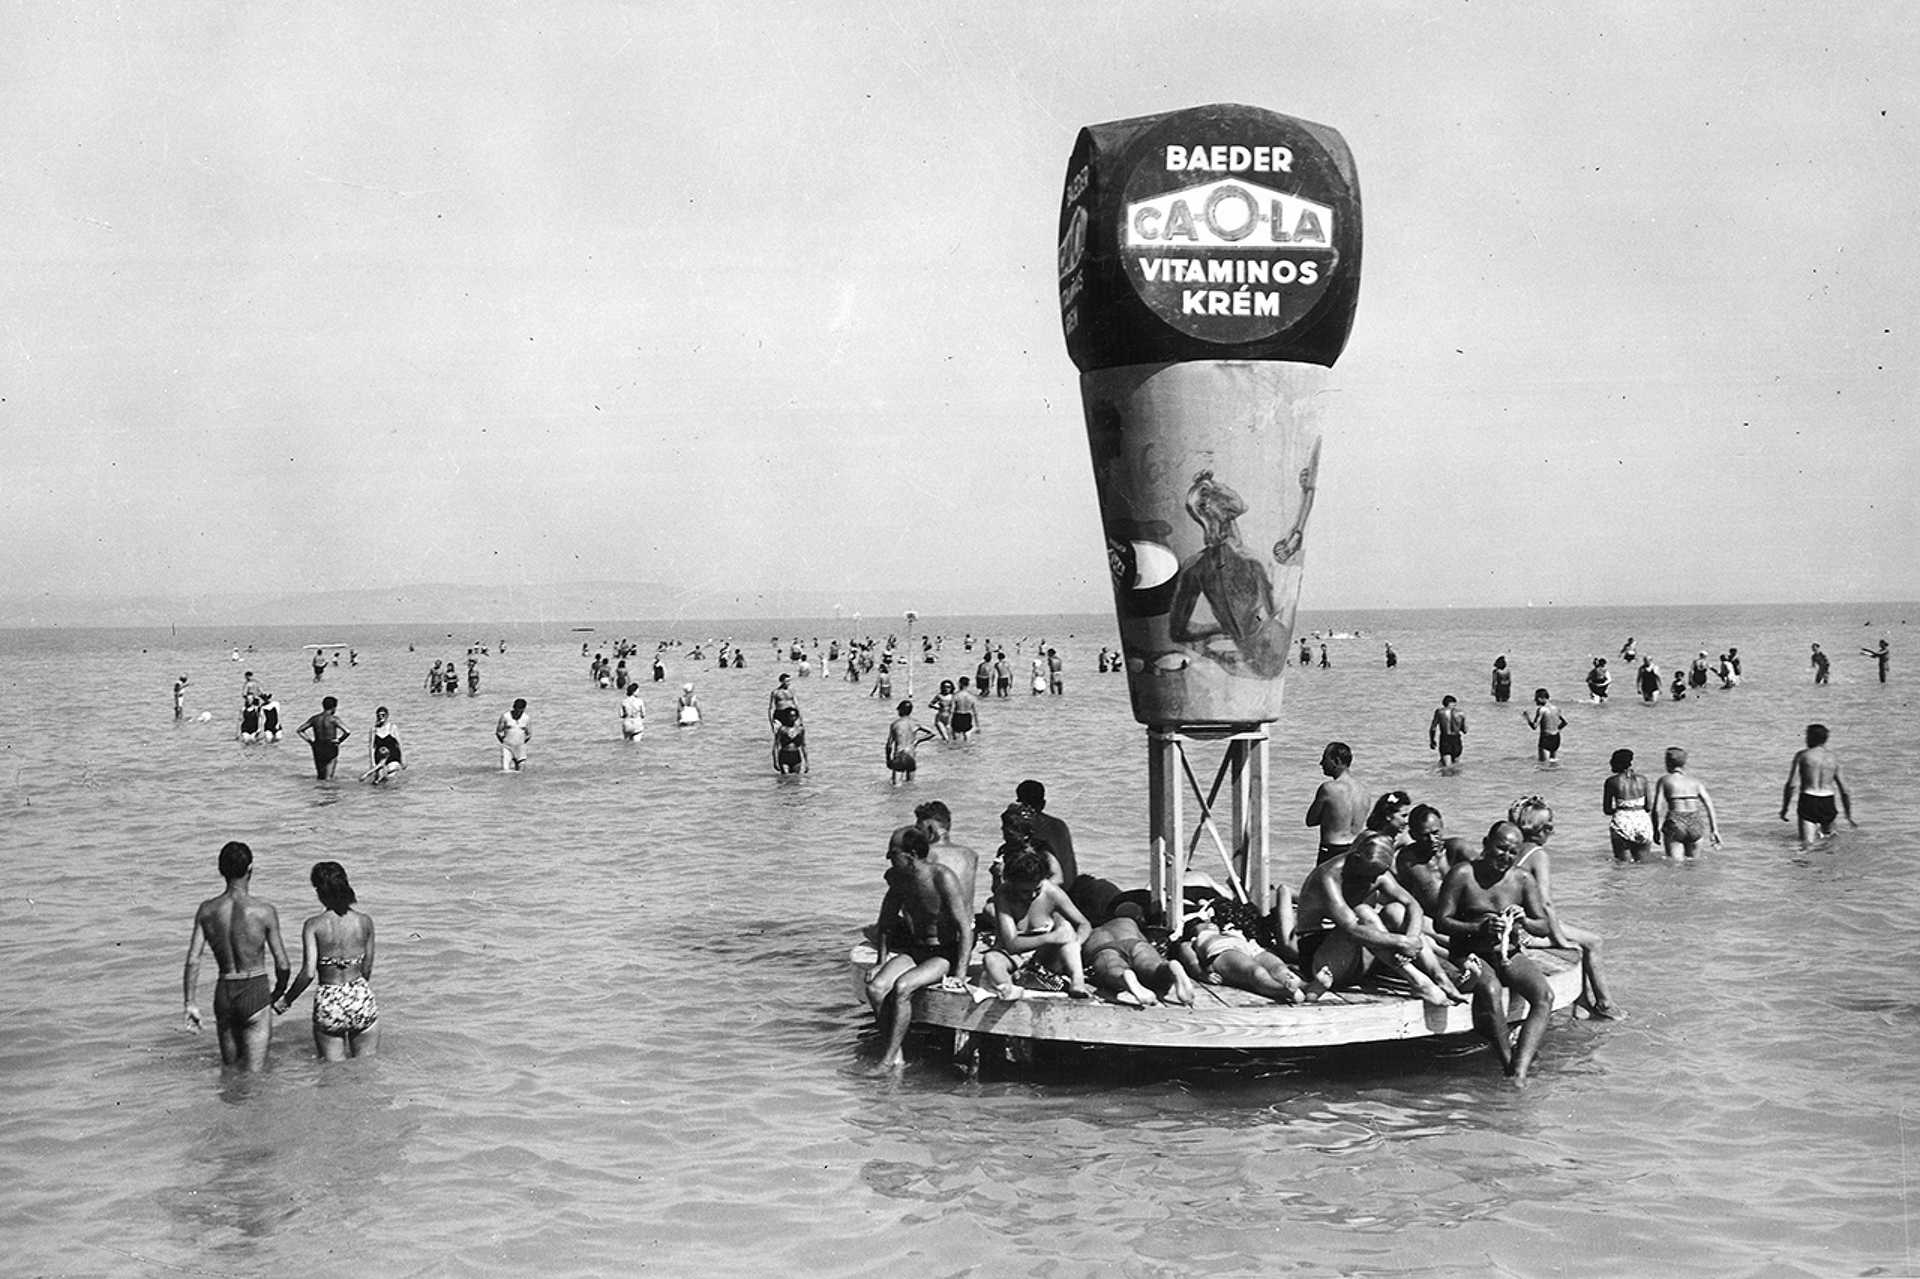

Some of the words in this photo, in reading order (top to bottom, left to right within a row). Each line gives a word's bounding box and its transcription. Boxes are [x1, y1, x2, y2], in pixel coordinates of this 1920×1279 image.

[1166, 145, 1292, 172] BAEDER
[1139, 258, 1319, 284] VITAMINOS
[1183, 285, 1281, 316] KRÉM
